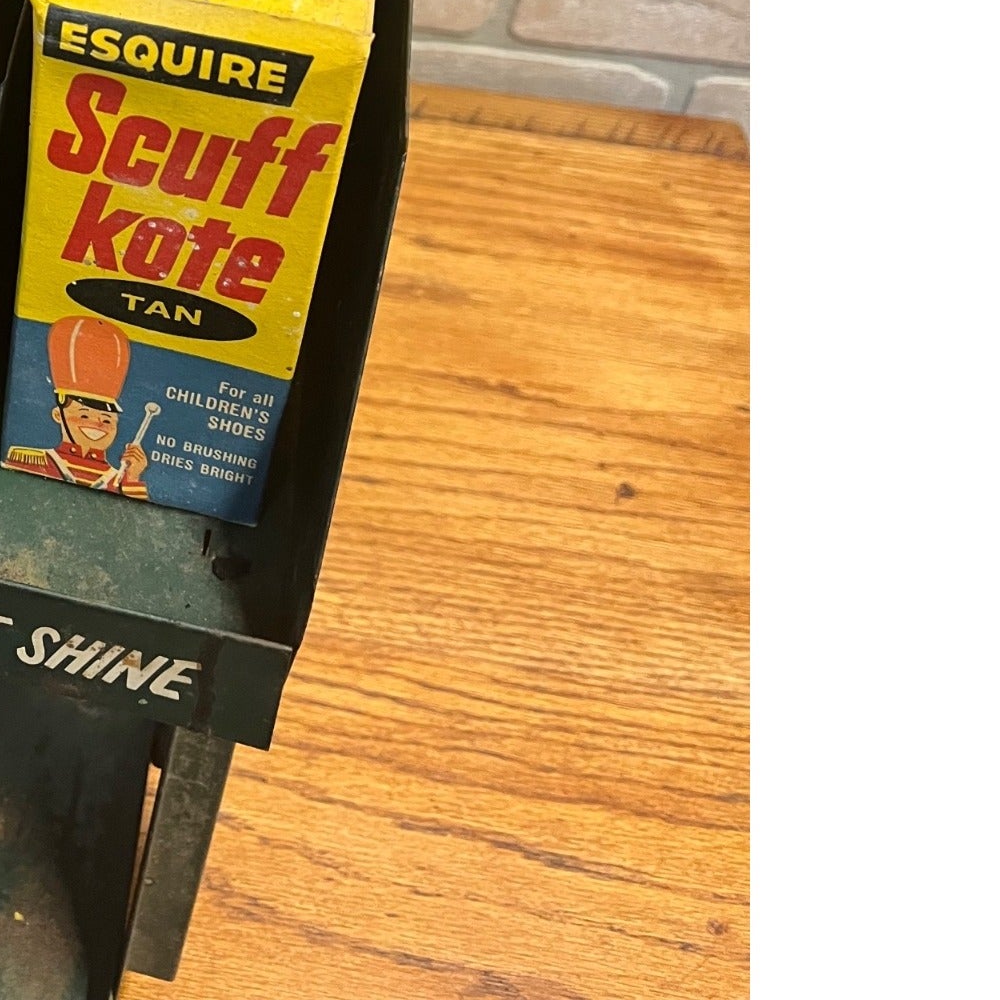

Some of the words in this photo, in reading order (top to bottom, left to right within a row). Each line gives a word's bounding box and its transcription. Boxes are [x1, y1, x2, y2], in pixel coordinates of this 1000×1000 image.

[59, 20, 288, 94] ESQUIRE
[47, 72, 343, 218] Scuff
[61, 180, 286, 304] kote
[121, 293, 202, 326] TAN
[165, 386, 270, 425] CHILDREN'S
[219, 381, 246, 399] For
[252, 393, 274, 407] all
[207, 416, 266, 442] SHOES
[151, 451, 193, 471] DRIES
[200, 463, 254, 485] BRIGHT
[156, 434, 175, 448] NO
[183, 441, 258, 469] BRUSHING
[16, 626, 202, 701] SHINE
